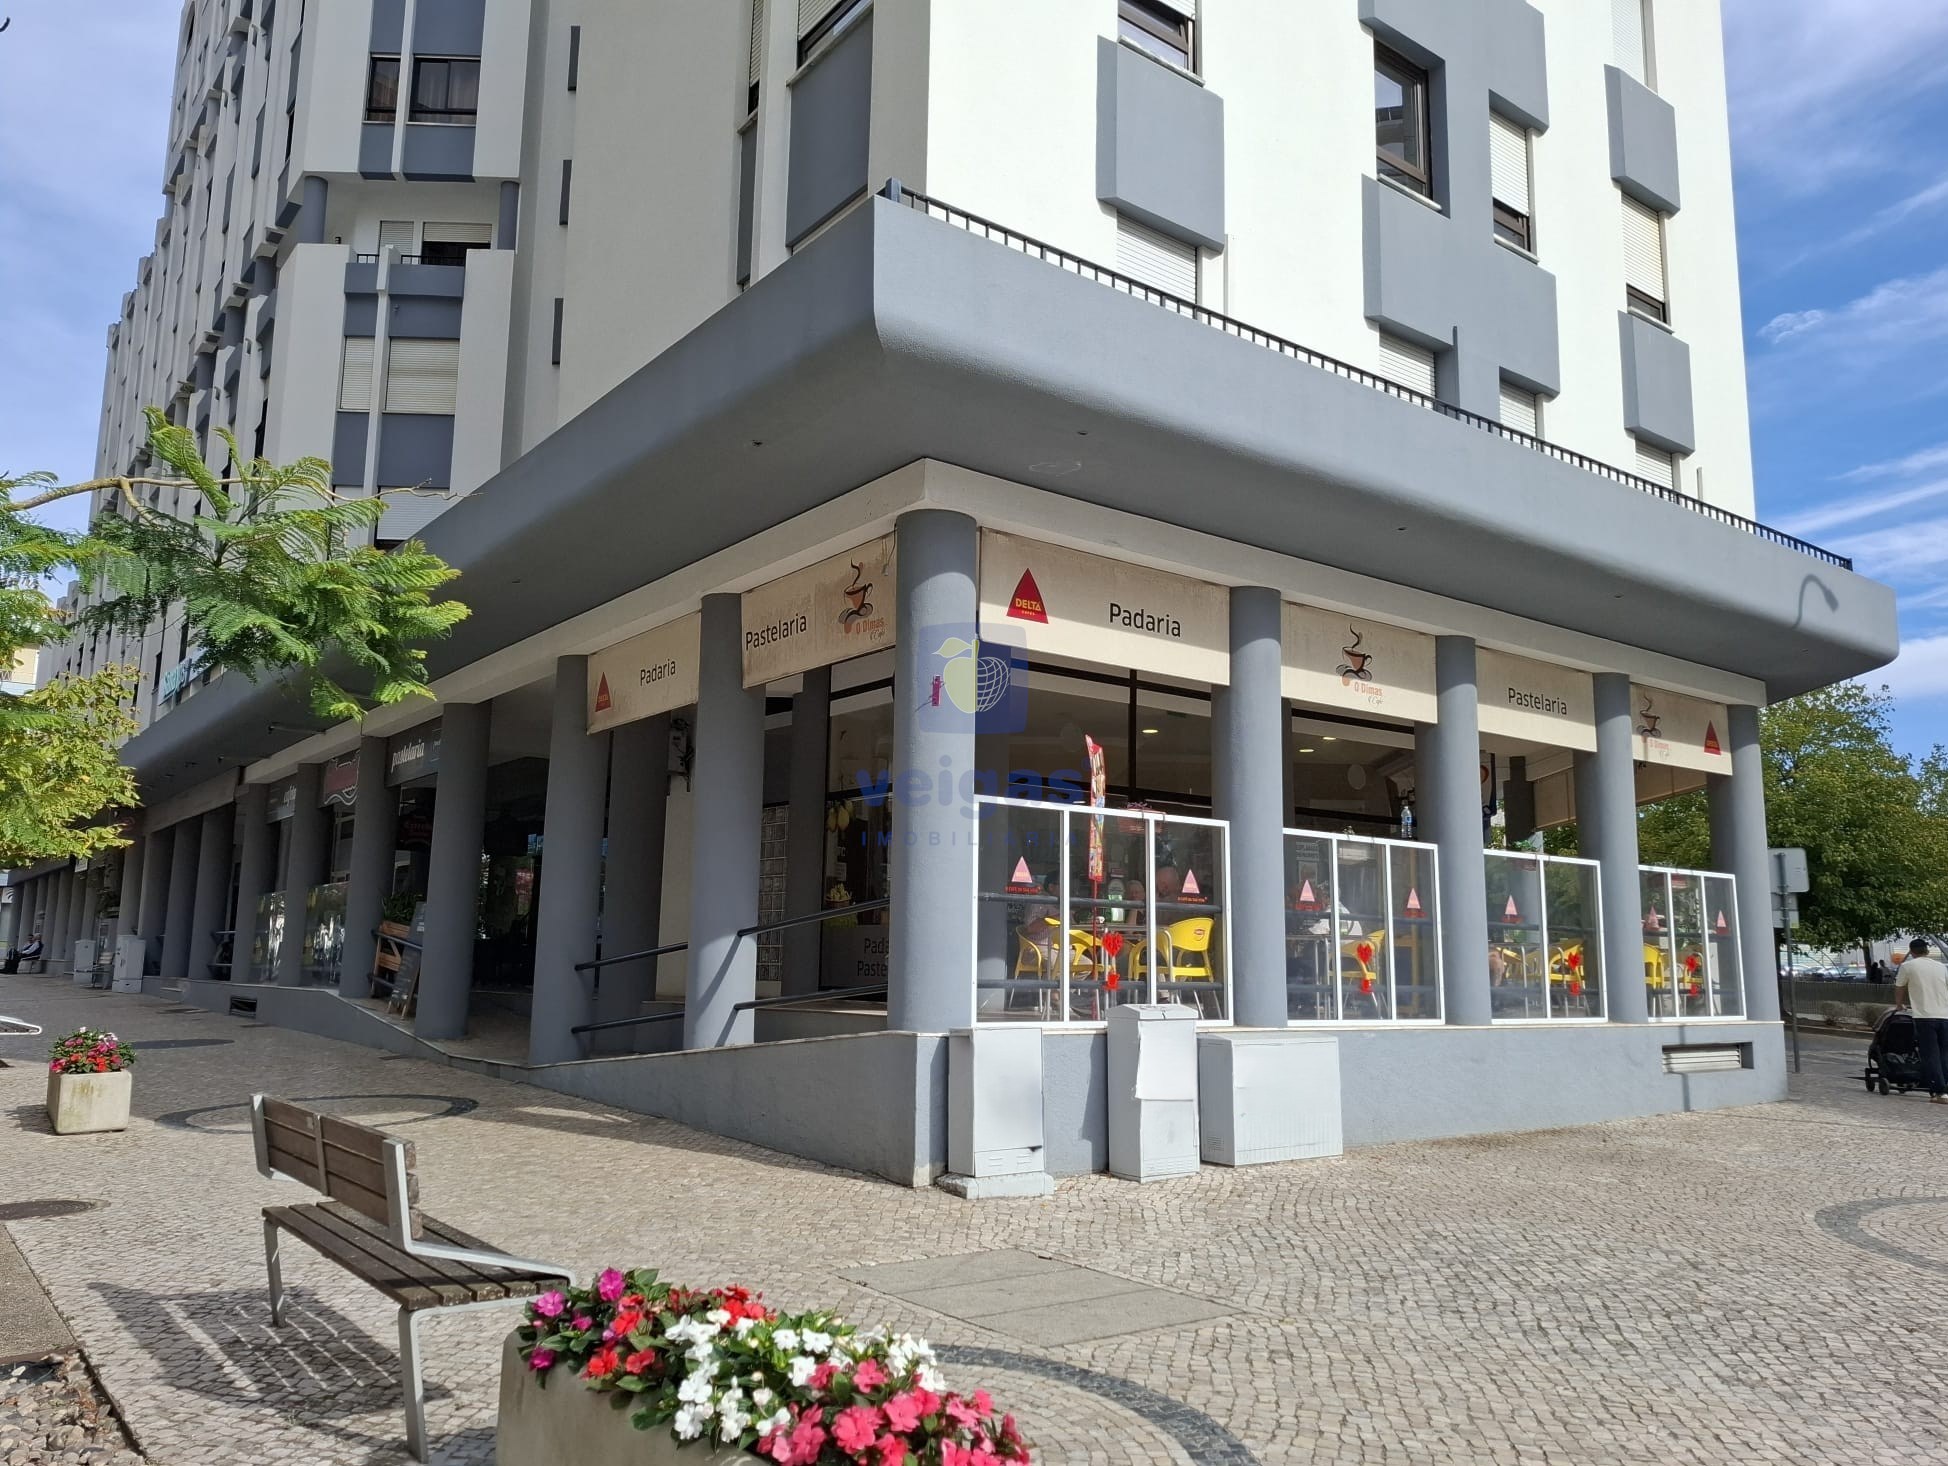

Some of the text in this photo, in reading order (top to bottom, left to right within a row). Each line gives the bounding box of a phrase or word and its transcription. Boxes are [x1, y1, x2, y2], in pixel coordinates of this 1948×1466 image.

[1015, 598, 1042, 611] DELTA
[1109, 602, 1181, 637] Padaria
[745, 613, 807, 651] Pastelaria
[640, 658, 676, 686] Padaria
[1508, 687, 1567, 715] Pastelaria
[391, 738, 425, 773] pastelaria
